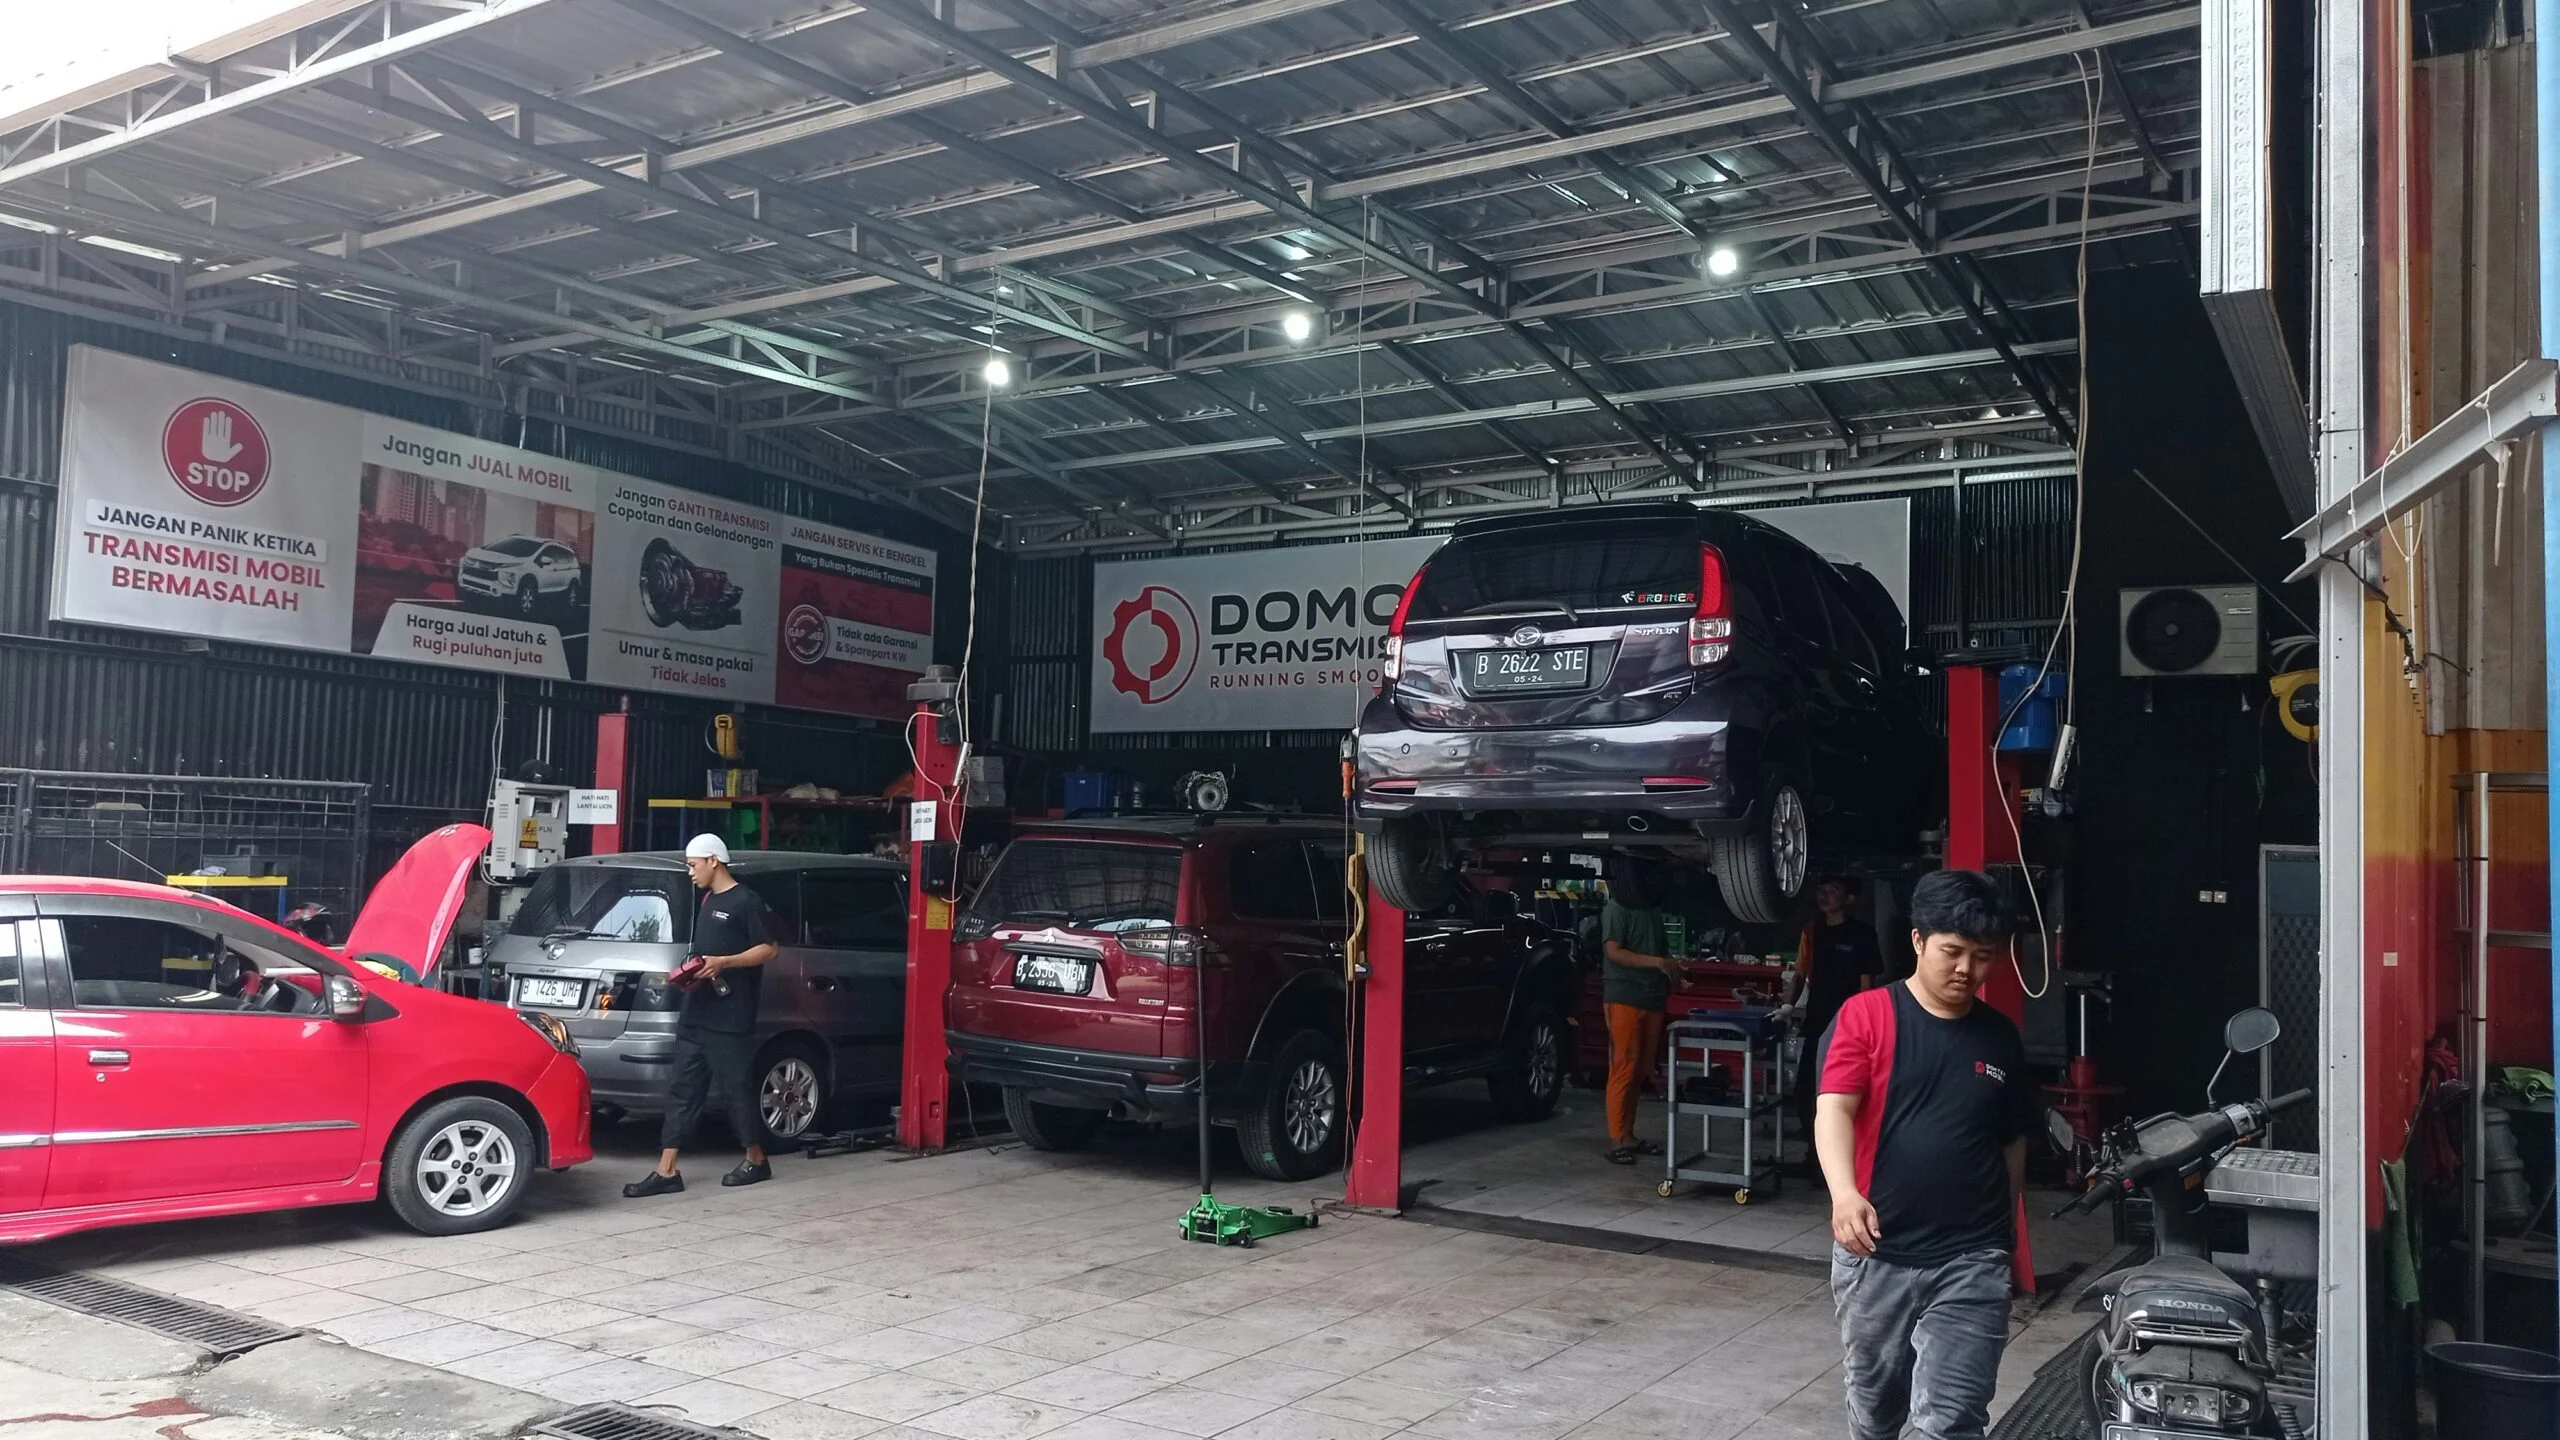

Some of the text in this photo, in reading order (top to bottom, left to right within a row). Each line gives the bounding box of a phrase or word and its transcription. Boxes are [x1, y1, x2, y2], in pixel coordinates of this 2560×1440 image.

[187, 462, 250, 493] STOP
[383, 435, 573, 492] Jangan JUAL MOBIL
[615, 486, 770, 532] Jangan GANTI TRANSMISI
[98, 507, 317, 557] JANGAN PANIK KETIKA
[608, 503, 774, 550] Copotan dan Gelondongan
[84, 531, 325, 588] TRANSMISI MOBIL
[791, 526, 926, 568] JANGAN SERVIS KE BENGKEL
[796, 553, 921, 588] Yang Bukan Spesialis Transmisi
[112, 565, 299, 611] BERMASALAH
[1211, 583, 1407, 636] DOMO
[407, 614, 548, 646] Harga Jual Jatuh &
[837, 627, 918, 650] Tidak ada Garansi
[413, 635, 543, 664] Rugi puluhan juta
[619, 640, 753, 673] Umur & masa pakai
[835, 642, 908, 663] & Sparepart KW
[1477, 650, 1584, 674] B 2622 STE
[651, 666, 726, 688] Tidak Jelas
[1211, 671, 1305, 689] RUNNING
[1016, 960, 1024, 977] B
[1064, 963, 1088, 982] UBN
[523, 980, 531, 994] B
[535, 981, 558, 997] 1426
[2157, 1299, 2226, 1313] HONDA
